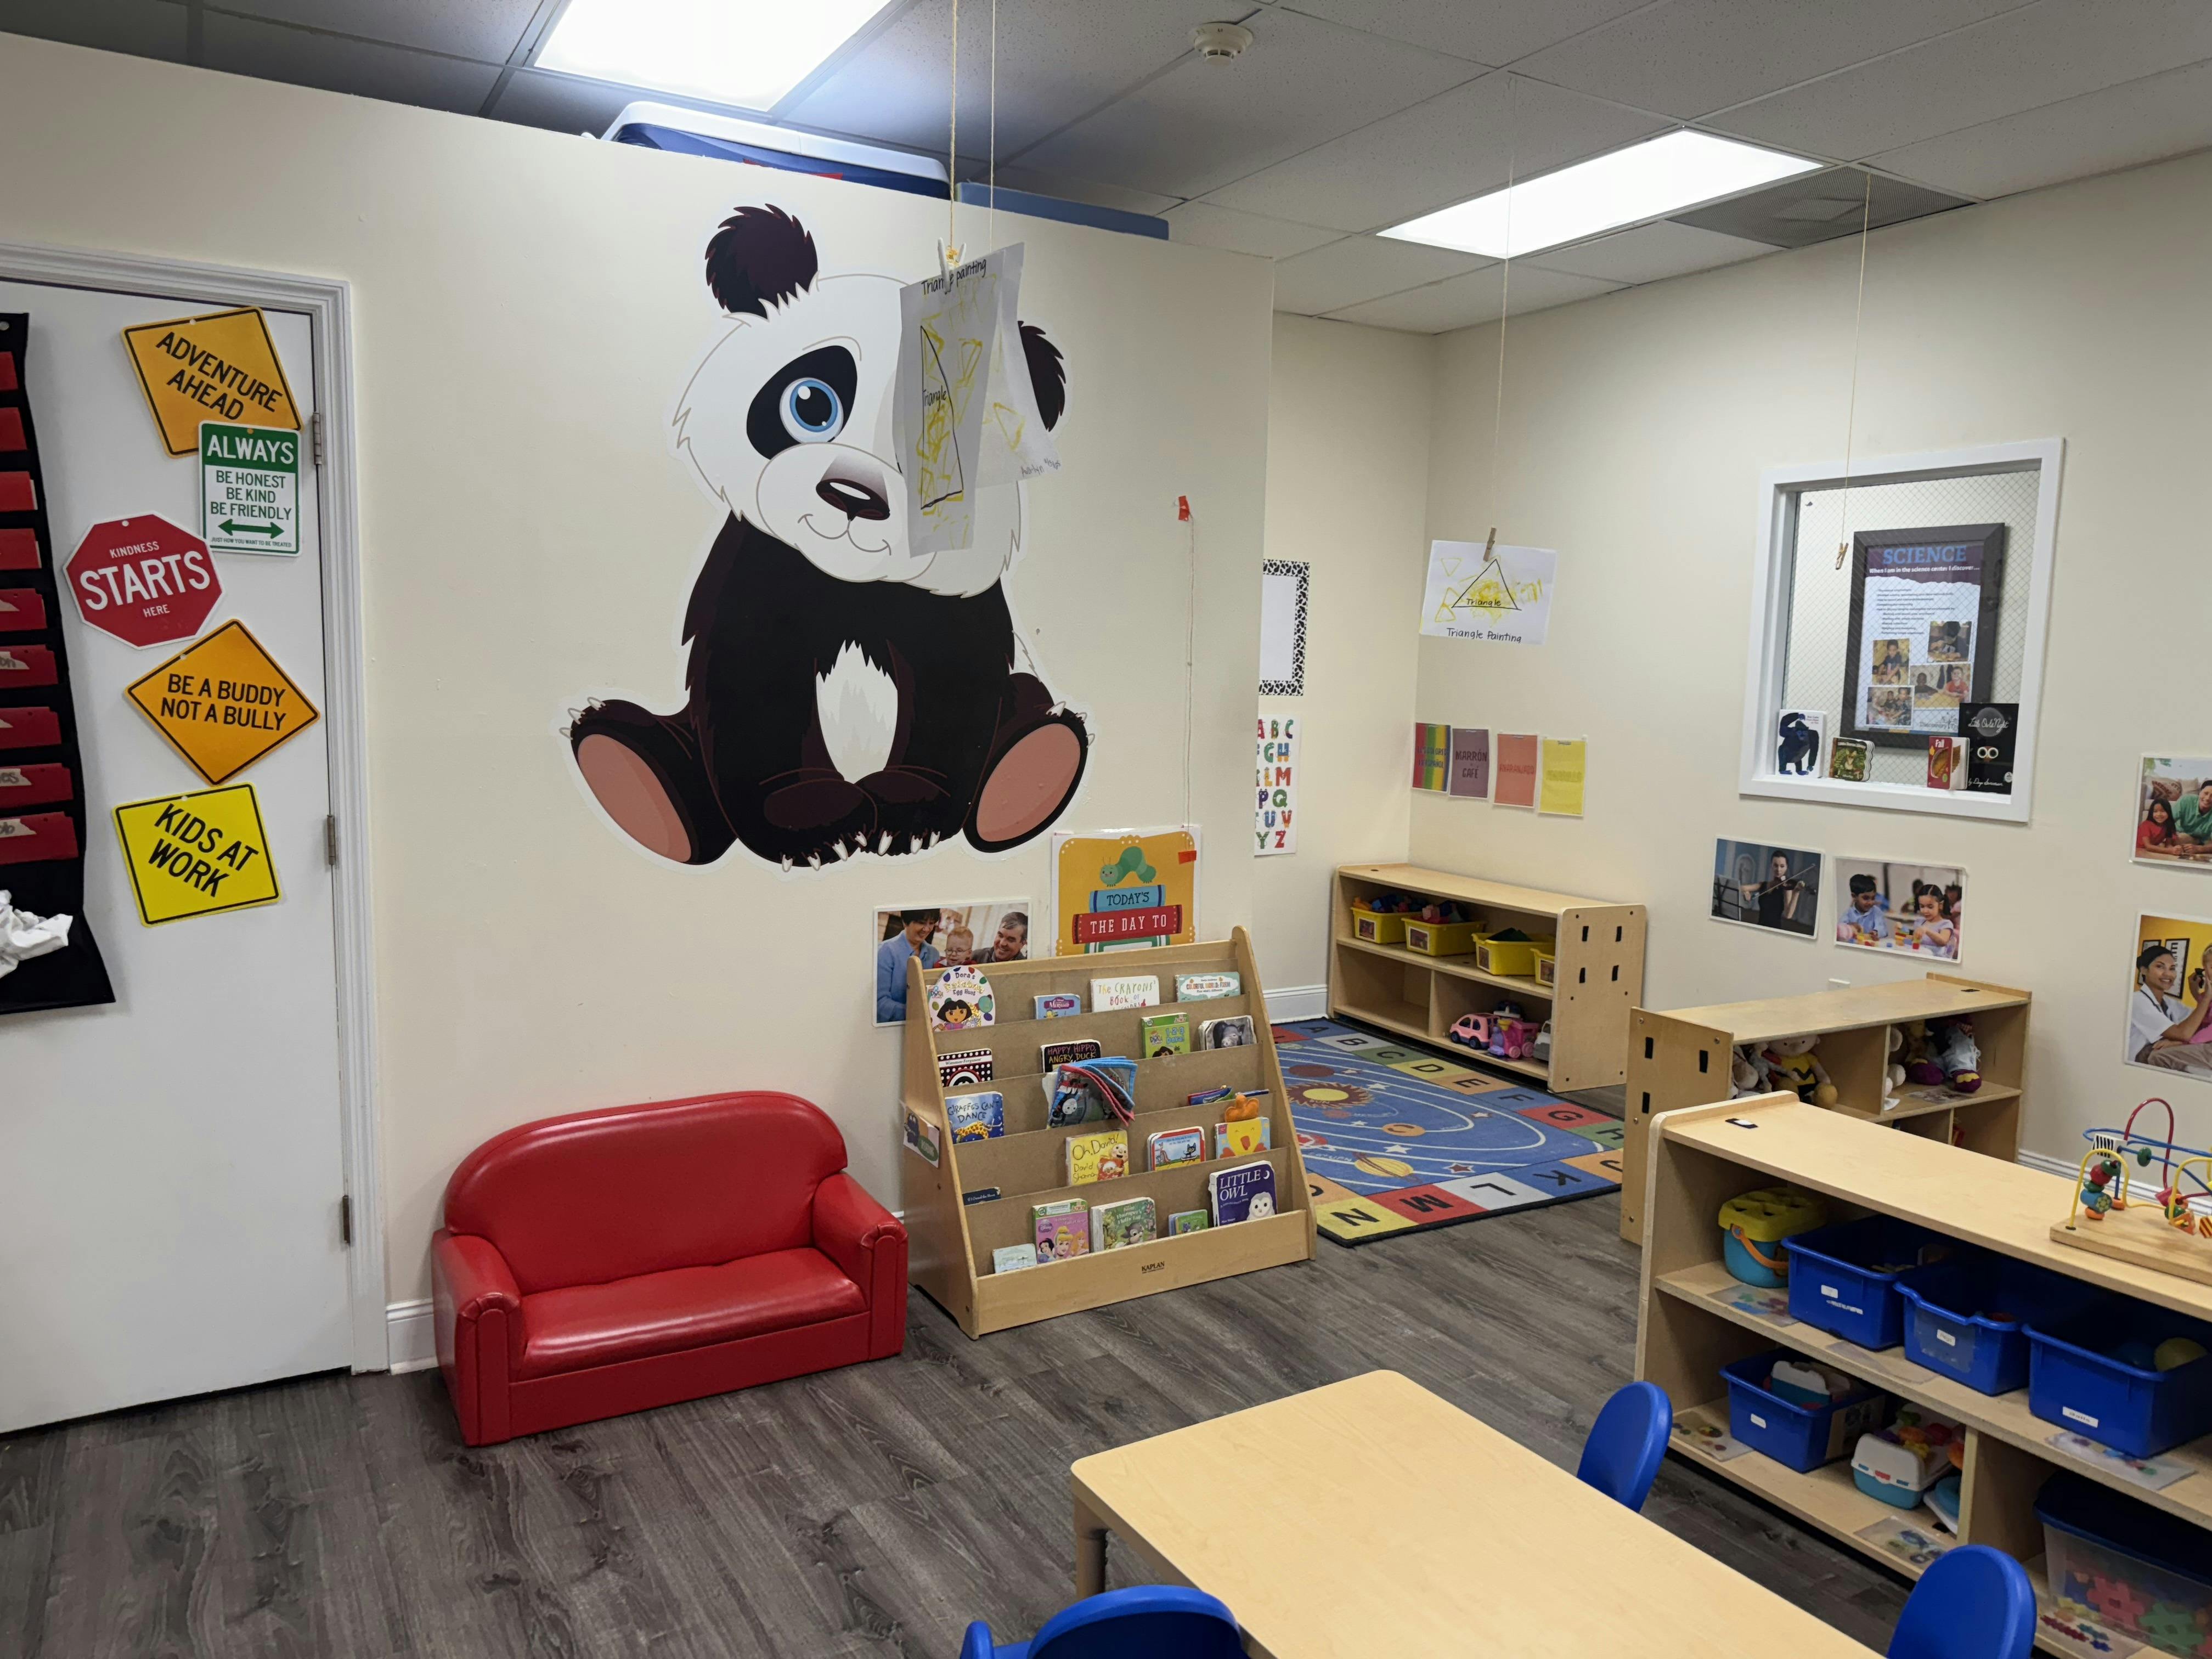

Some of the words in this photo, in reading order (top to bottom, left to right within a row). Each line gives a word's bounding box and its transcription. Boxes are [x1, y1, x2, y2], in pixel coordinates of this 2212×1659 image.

[921, 273, 953, 295] Triane
[956, 259, 987, 287] painting
[155, 332, 283, 412] ADVENTURE
[166, 369, 244, 420] AHEAD
[207, 435, 294, 464] ALWAYS
[216, 470, 233, 484] BE
[236, 472, 286, 488] HONEST
[227, 487, 242, 500] BE
[246, 488, 276, 503] KIND
[211, 501, 227, 515] BE
[230, 503, 292, 520] FRIENDLY
[109, 541, 160, 558] KINDNESS
[1883, 545, 1967, 565] SCIENCE
[80, 550, 211, 610] STARTS
[143, 604, 170, 618] HERE
[1466, 598, 1502, 607] Triangle
[1447, 628, 1483, 640] Triangle
[1487, 631, 1522, 644] Painting
[168, 673, 195, 695] BE
[198, 678, 211, 698] A
[218, 680, 286, 707] BUDDY
[161, 697, 201, 720] NOT
[204, 703, 217, 723] A
[223, 706, 286, 731] BULLY
[1271, 719, 1279, 739] B
[1285, 719, 1294, 739] C
[1263, 742, 1274, 763] G
[1277, 743, 1290, 762] H
[1935, 739, 1945, 748] Fall
[1455, 749, 1487, 761] MARRÓN
[1264, 768, 1273, 787] L
[1275, 766, 1292, 786] M
[1462, 766, 1479, 778] CAFÉ
[1259, 789, 1269, 809] P
[1272, 789, 1288, 808] Q
[1264, 809, 1277, 828] U
[1281, 809, 1292, 829] V
[154, 803, 223, 853] KIDS
[216, 840, 259, 871] AT
[1256, 831, 1269, 849] Y
[1274, 830, 1286, 848] Z
[148, 838, 230, 897] WORK
[1107, 891, 1149, 906] TODAY'S
[1090, 919, 1114, 934] THE
[1122, 916, 1145, 931] DAY
[1153, 915, 1166, 928] TO
[1115, 980, 1156, 995] CRAYONS'
[1048, 1046, 1071, 1055] HAPPY
[1048, 1054, 1073, 1064] ANGRY
[1076, 1052, 1096, 1060] DUCK
[1410, 1064, 1444, 1073] D
[1452, 1078, 1491, 1088] E
[957, 1111, 987, 1124] DANCE
[1548, 1110, 1584, 1121] G
[1091, 1133, 1119, 1155] David!
[1074, 1161, 1093, 1172] David
[1220, 1169, 1261, 1189] LITTLE
[1532, 1170, 1582, 1186] K
[1220, 1184, 1248, 1201] OWL
[1470, 1183, 1517, 1196] L
[1399, 1194, 1454, 1212] M
[1330, 1208, 1380, 1226] N
[1141, 1261, 1165, 1271] KAPLAN
